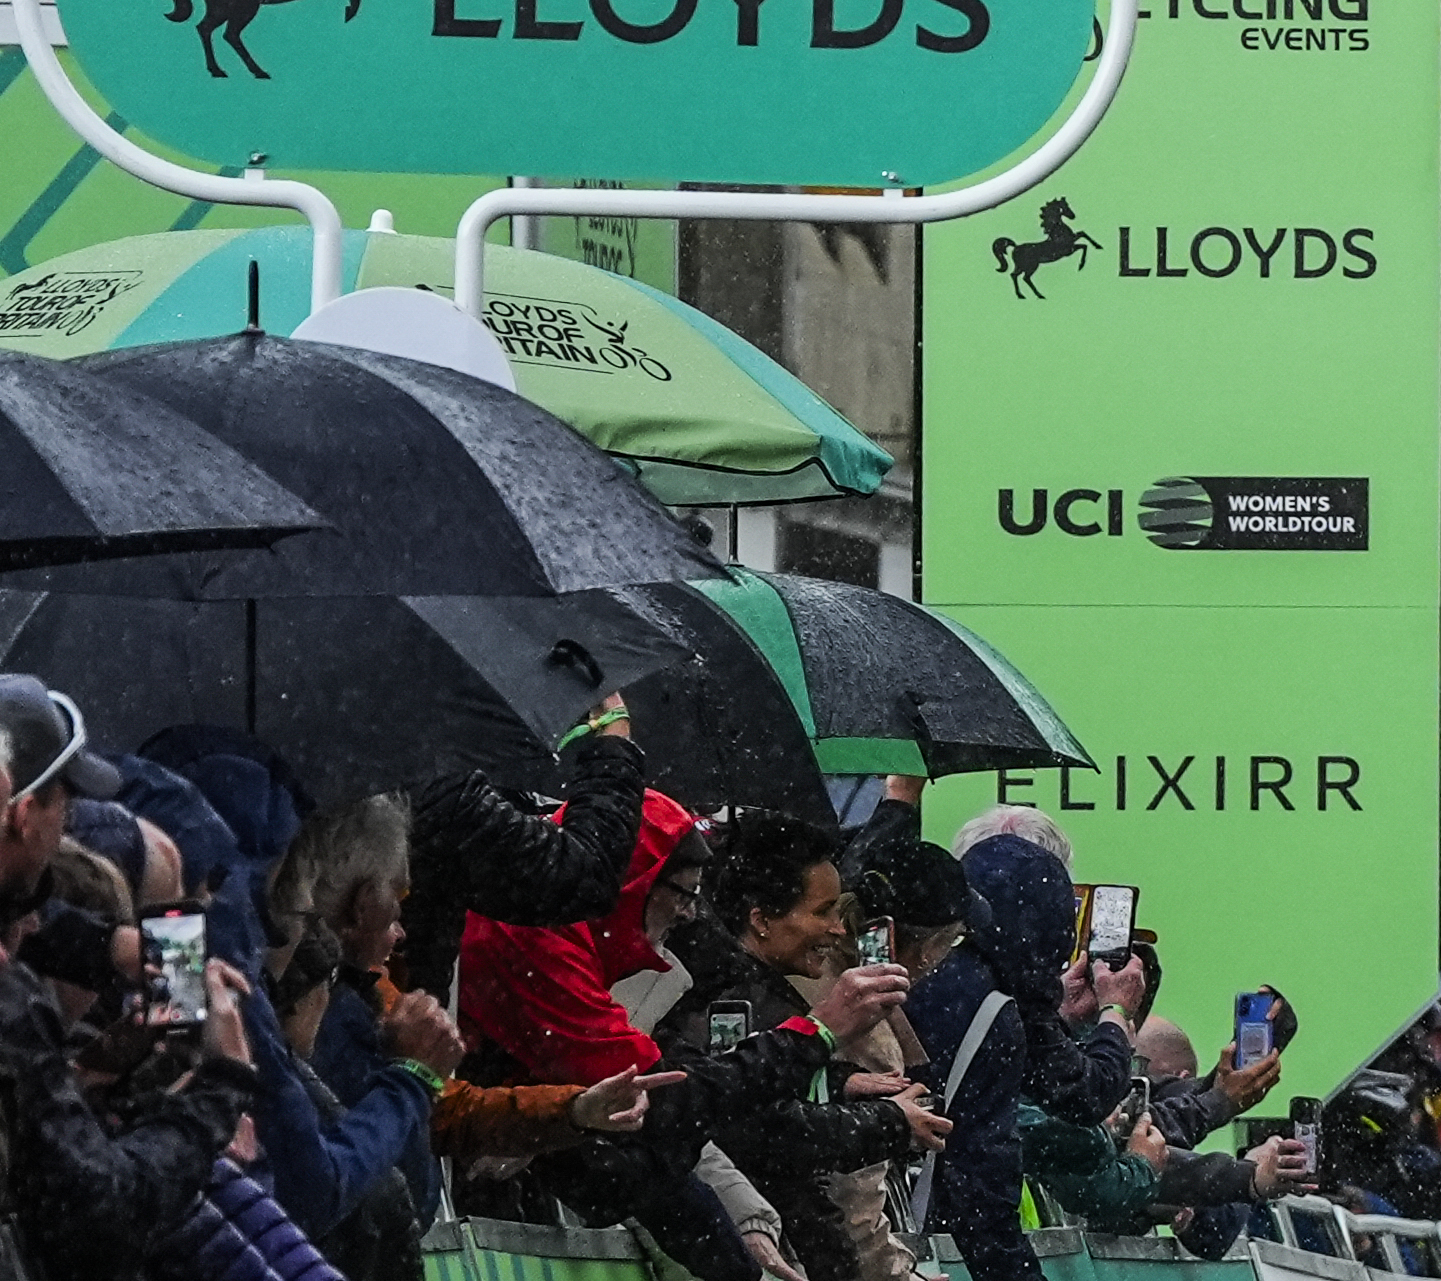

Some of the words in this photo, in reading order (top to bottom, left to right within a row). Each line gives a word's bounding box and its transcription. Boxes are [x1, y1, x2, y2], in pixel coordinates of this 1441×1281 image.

[1240, 27, 1370, 51] EVENTS
[1118, 226, 1378, 279] LLOYDS
[997, 488, 1124, 537] UCI
[1228, 494, 1331, 512] WOMEN'S
[1228, 515, 1356, 534] WORLDTOUR
[997, 755, 1363, 811] ELIXIRR
